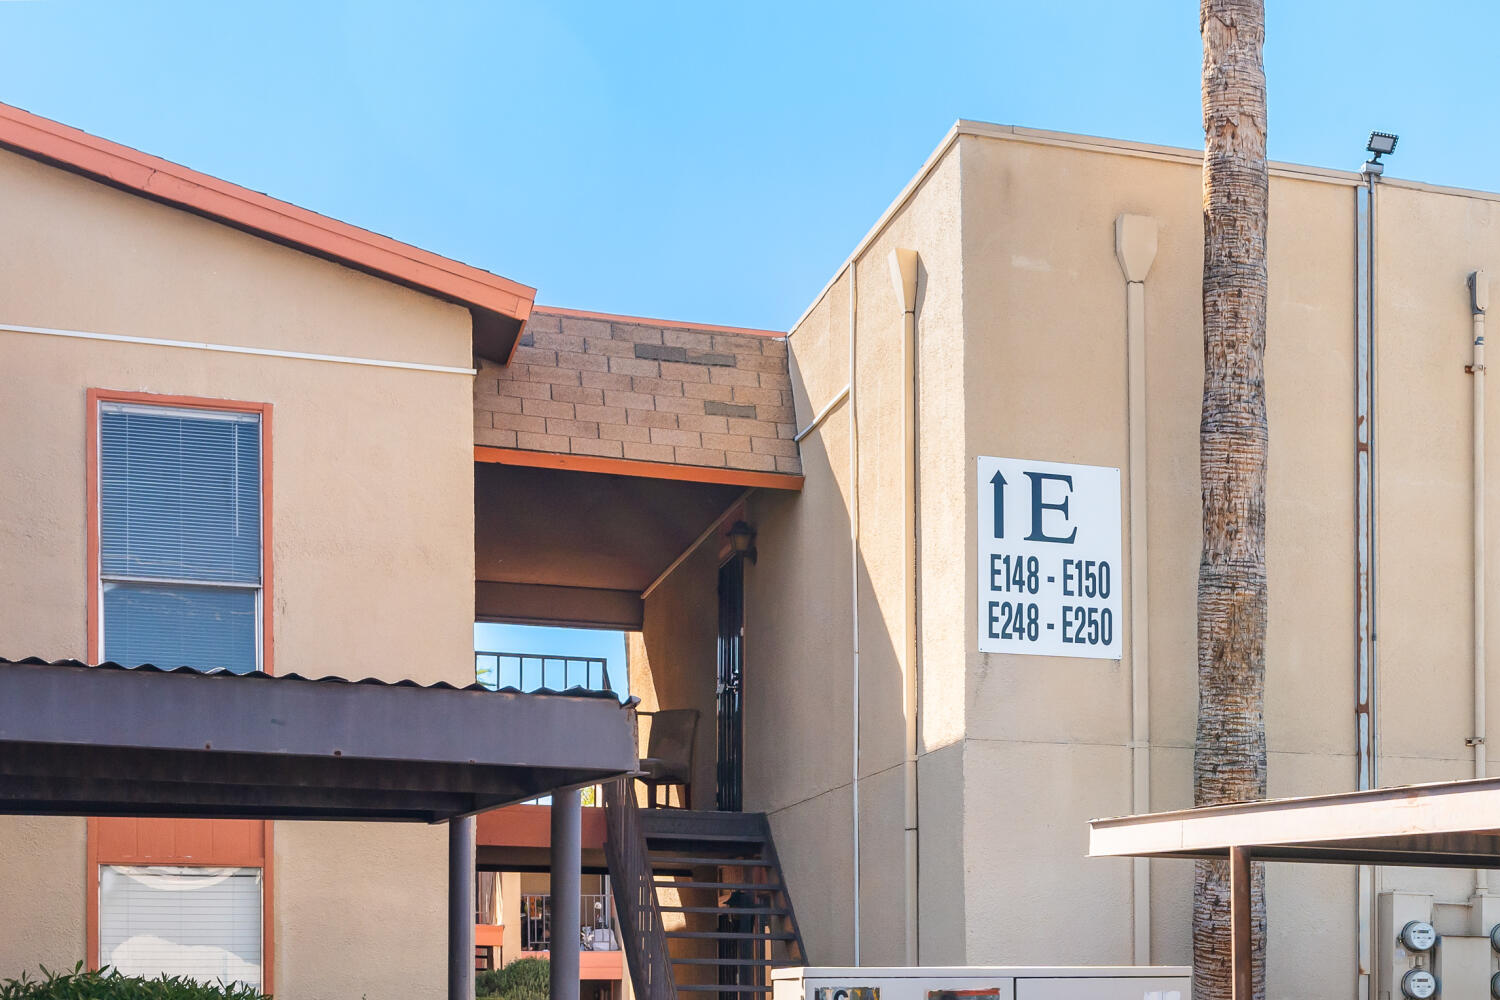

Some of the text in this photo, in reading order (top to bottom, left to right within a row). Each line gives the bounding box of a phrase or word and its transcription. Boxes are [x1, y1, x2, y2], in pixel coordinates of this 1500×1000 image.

[1022, 471, 1078, 545] E
[990, 553, 1040, 595] E148
[1062, 558, 1111, 600] E150
[988, 600, 1039, 642] E248
[1062, 605, 1113, 646] E250
